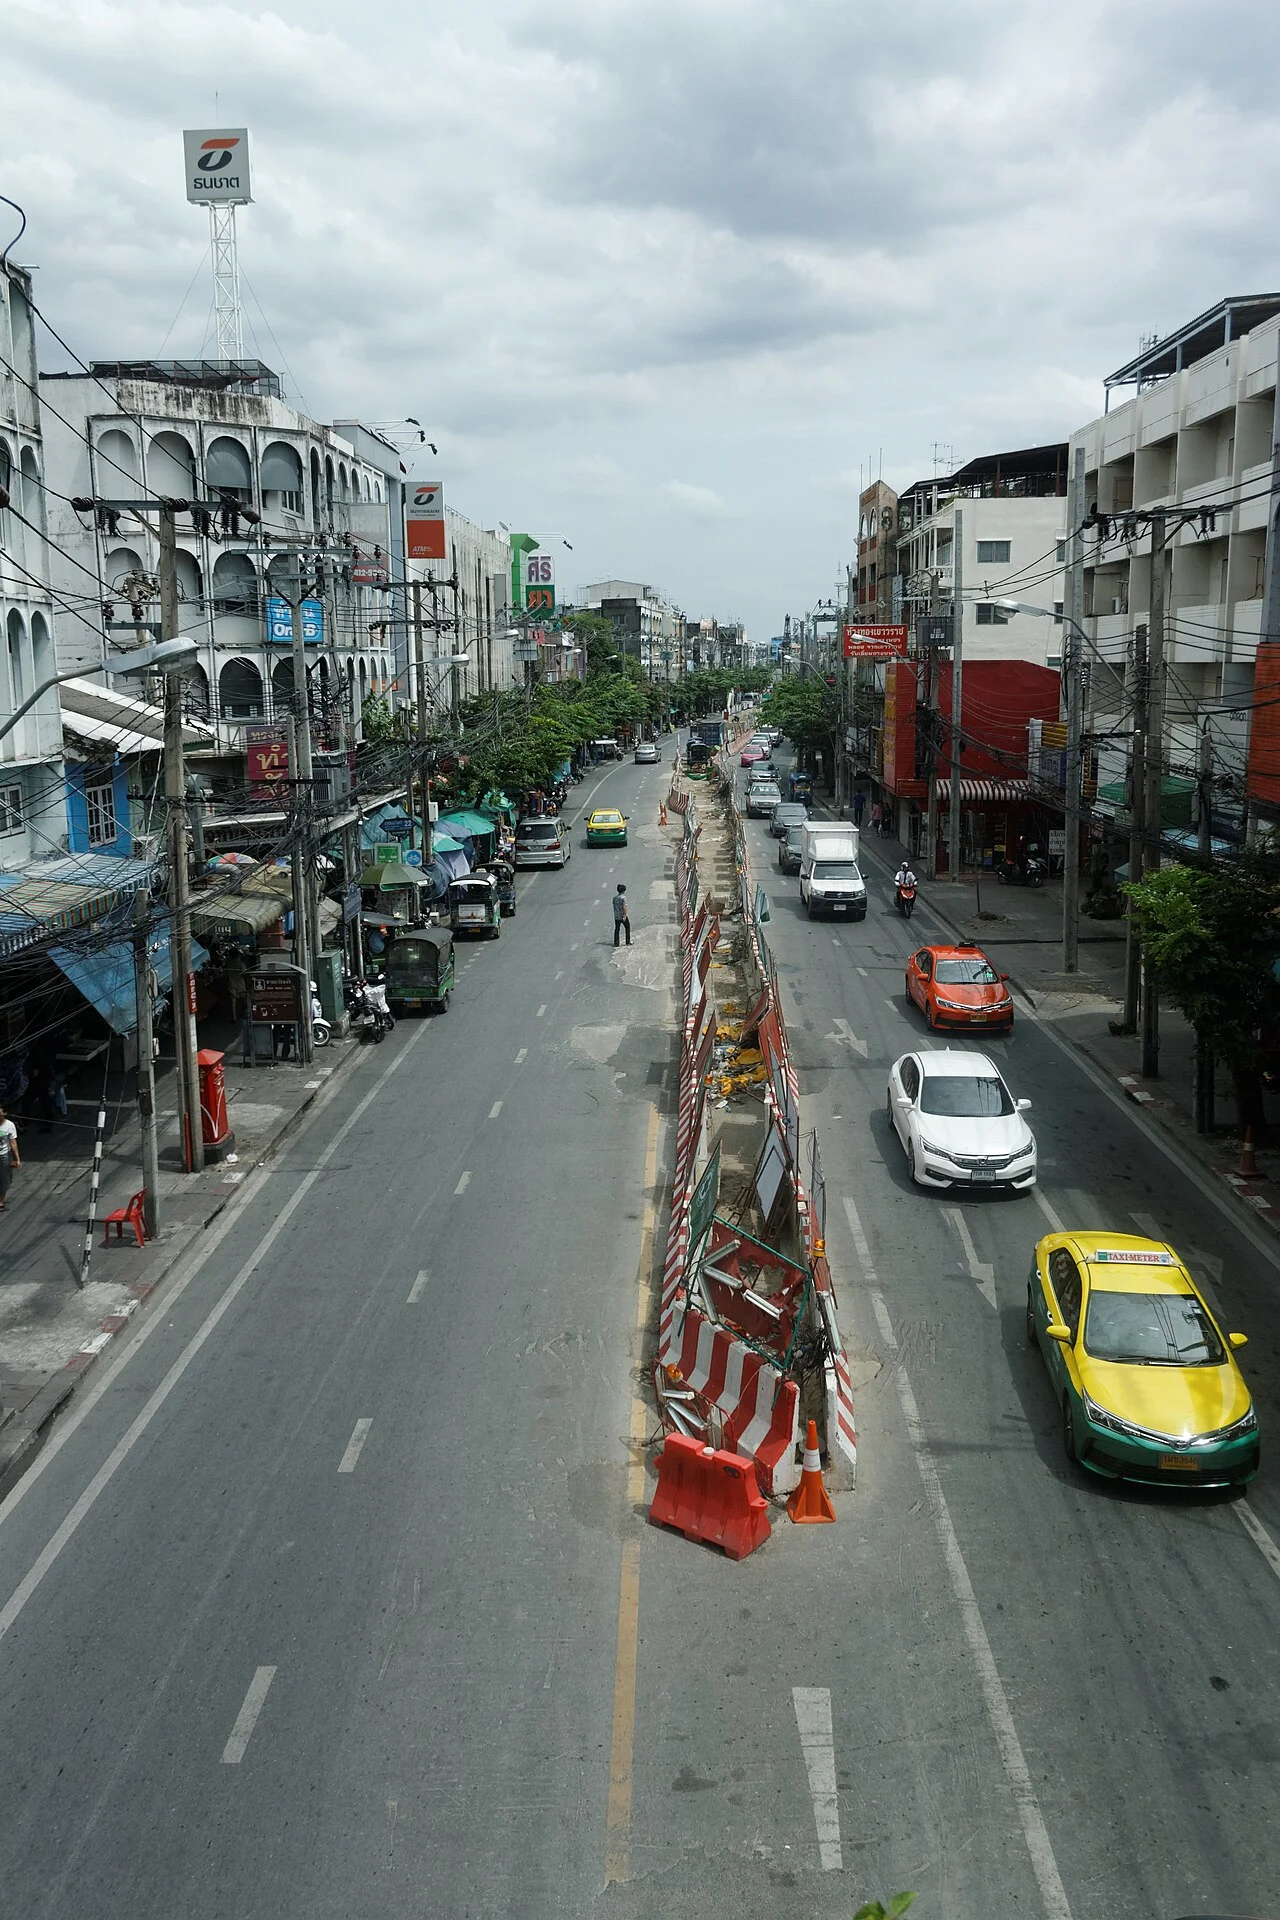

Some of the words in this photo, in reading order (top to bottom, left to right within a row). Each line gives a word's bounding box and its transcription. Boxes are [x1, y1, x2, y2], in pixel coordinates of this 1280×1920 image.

[194, 176, 240, 190] ธนชาต
[528, 590, 552, 609] ยา
[1108, 1253, 1160, 1262] TAXI-METER
